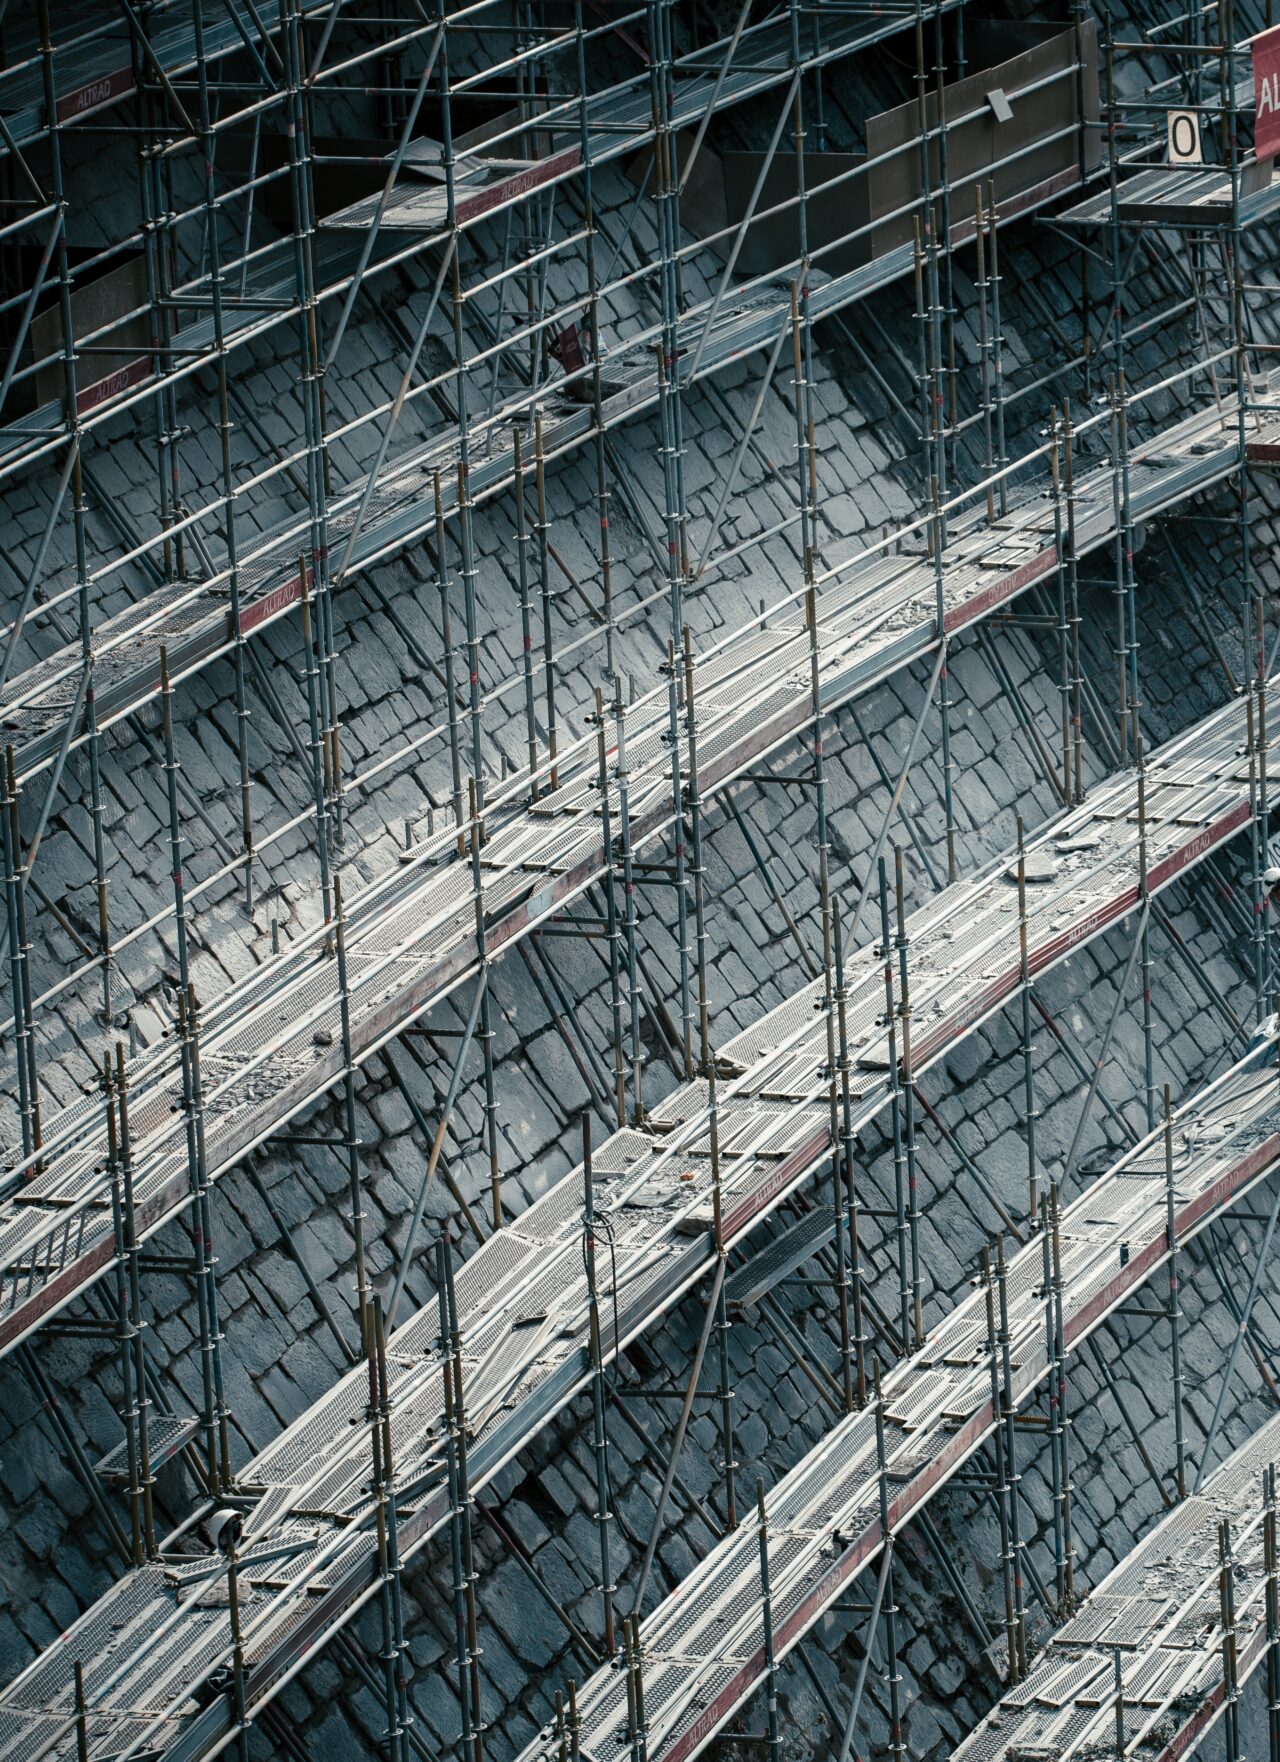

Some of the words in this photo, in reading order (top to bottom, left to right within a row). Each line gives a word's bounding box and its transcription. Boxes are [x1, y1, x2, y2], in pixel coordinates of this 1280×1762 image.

[78, 80, 110, 108] ALTRAD
[1172, 115, 1196, 157] 0
[502, 176, 533, 200] ALTRAD
[96, 373, 128, 402] ALTRAD
[263, 583, 295, 618] ALTRAD
[989, 575, 1017, 603] ALTRAD
[1183, 834, 1210, 862] ALTRAD
[1212, 1172, 1239, 1203] ALTRAD
[687, 1705, 718, 1749] ALTRAD
